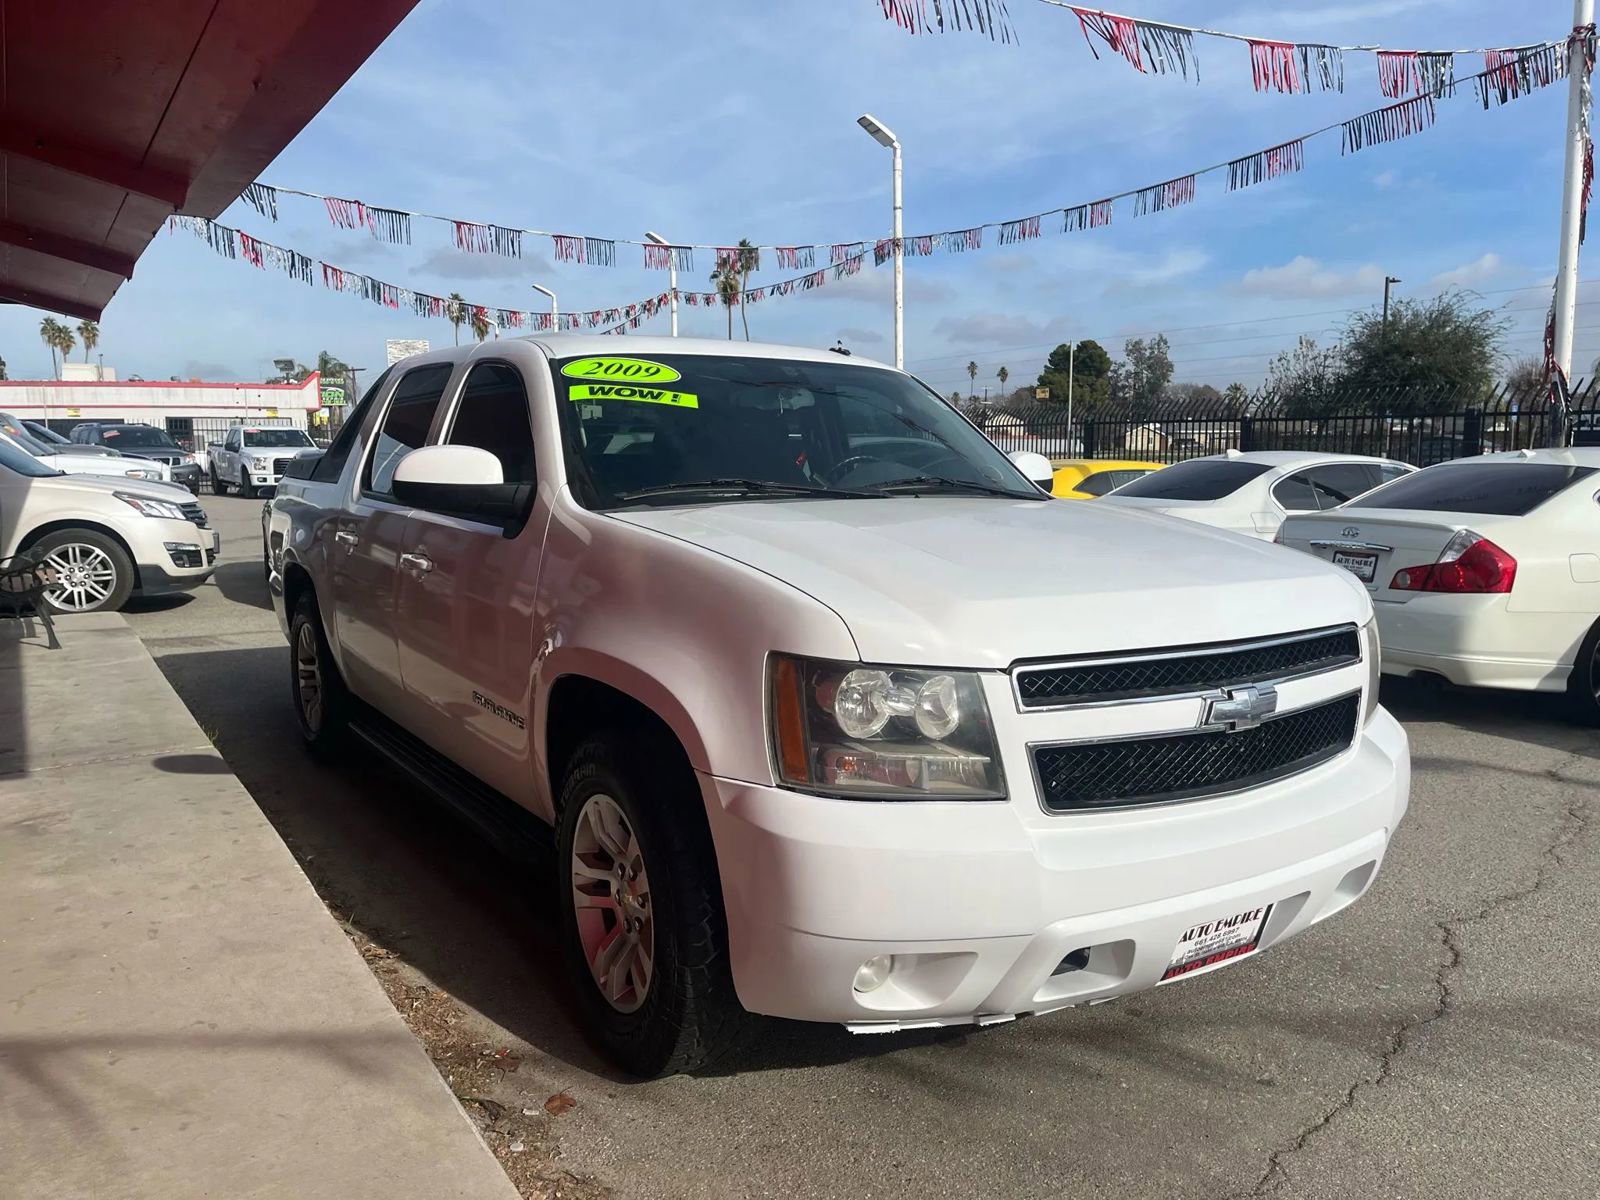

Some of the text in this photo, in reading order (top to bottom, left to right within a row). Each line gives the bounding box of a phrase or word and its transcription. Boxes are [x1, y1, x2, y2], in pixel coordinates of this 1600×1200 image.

[582, 361, 661, 377] 2009
[1178, 923, 1213, 944] AUTO
[1214, 908, 1263, 932] EMPIRE
[1167, 961, 1202, 977] AUTO
[1206, 943, 1255, 964] EMPIRE
